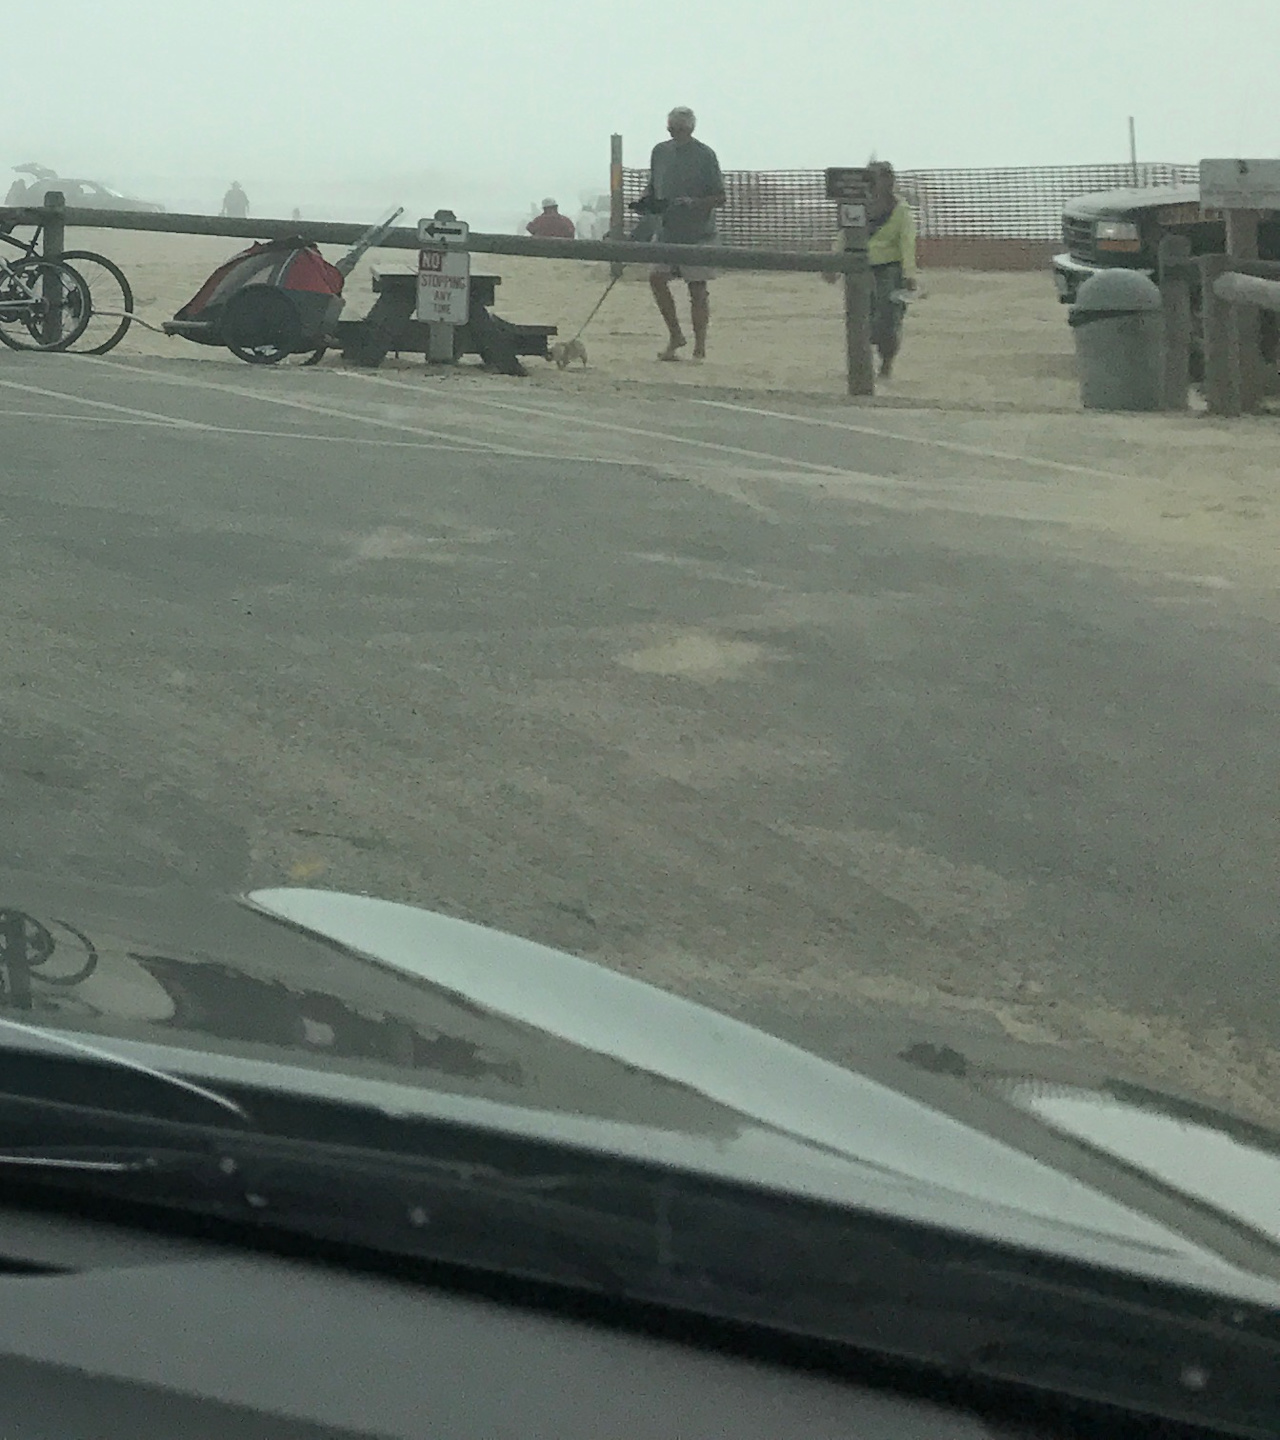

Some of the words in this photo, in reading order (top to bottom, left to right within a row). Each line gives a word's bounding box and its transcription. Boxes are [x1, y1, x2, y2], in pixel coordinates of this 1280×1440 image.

[422, 252, 440, 268] NO
[421, 274, 466, 290] STOPPING
[433, 290, 452, 302] ANY
[433, 303, 452, 315] TIME
